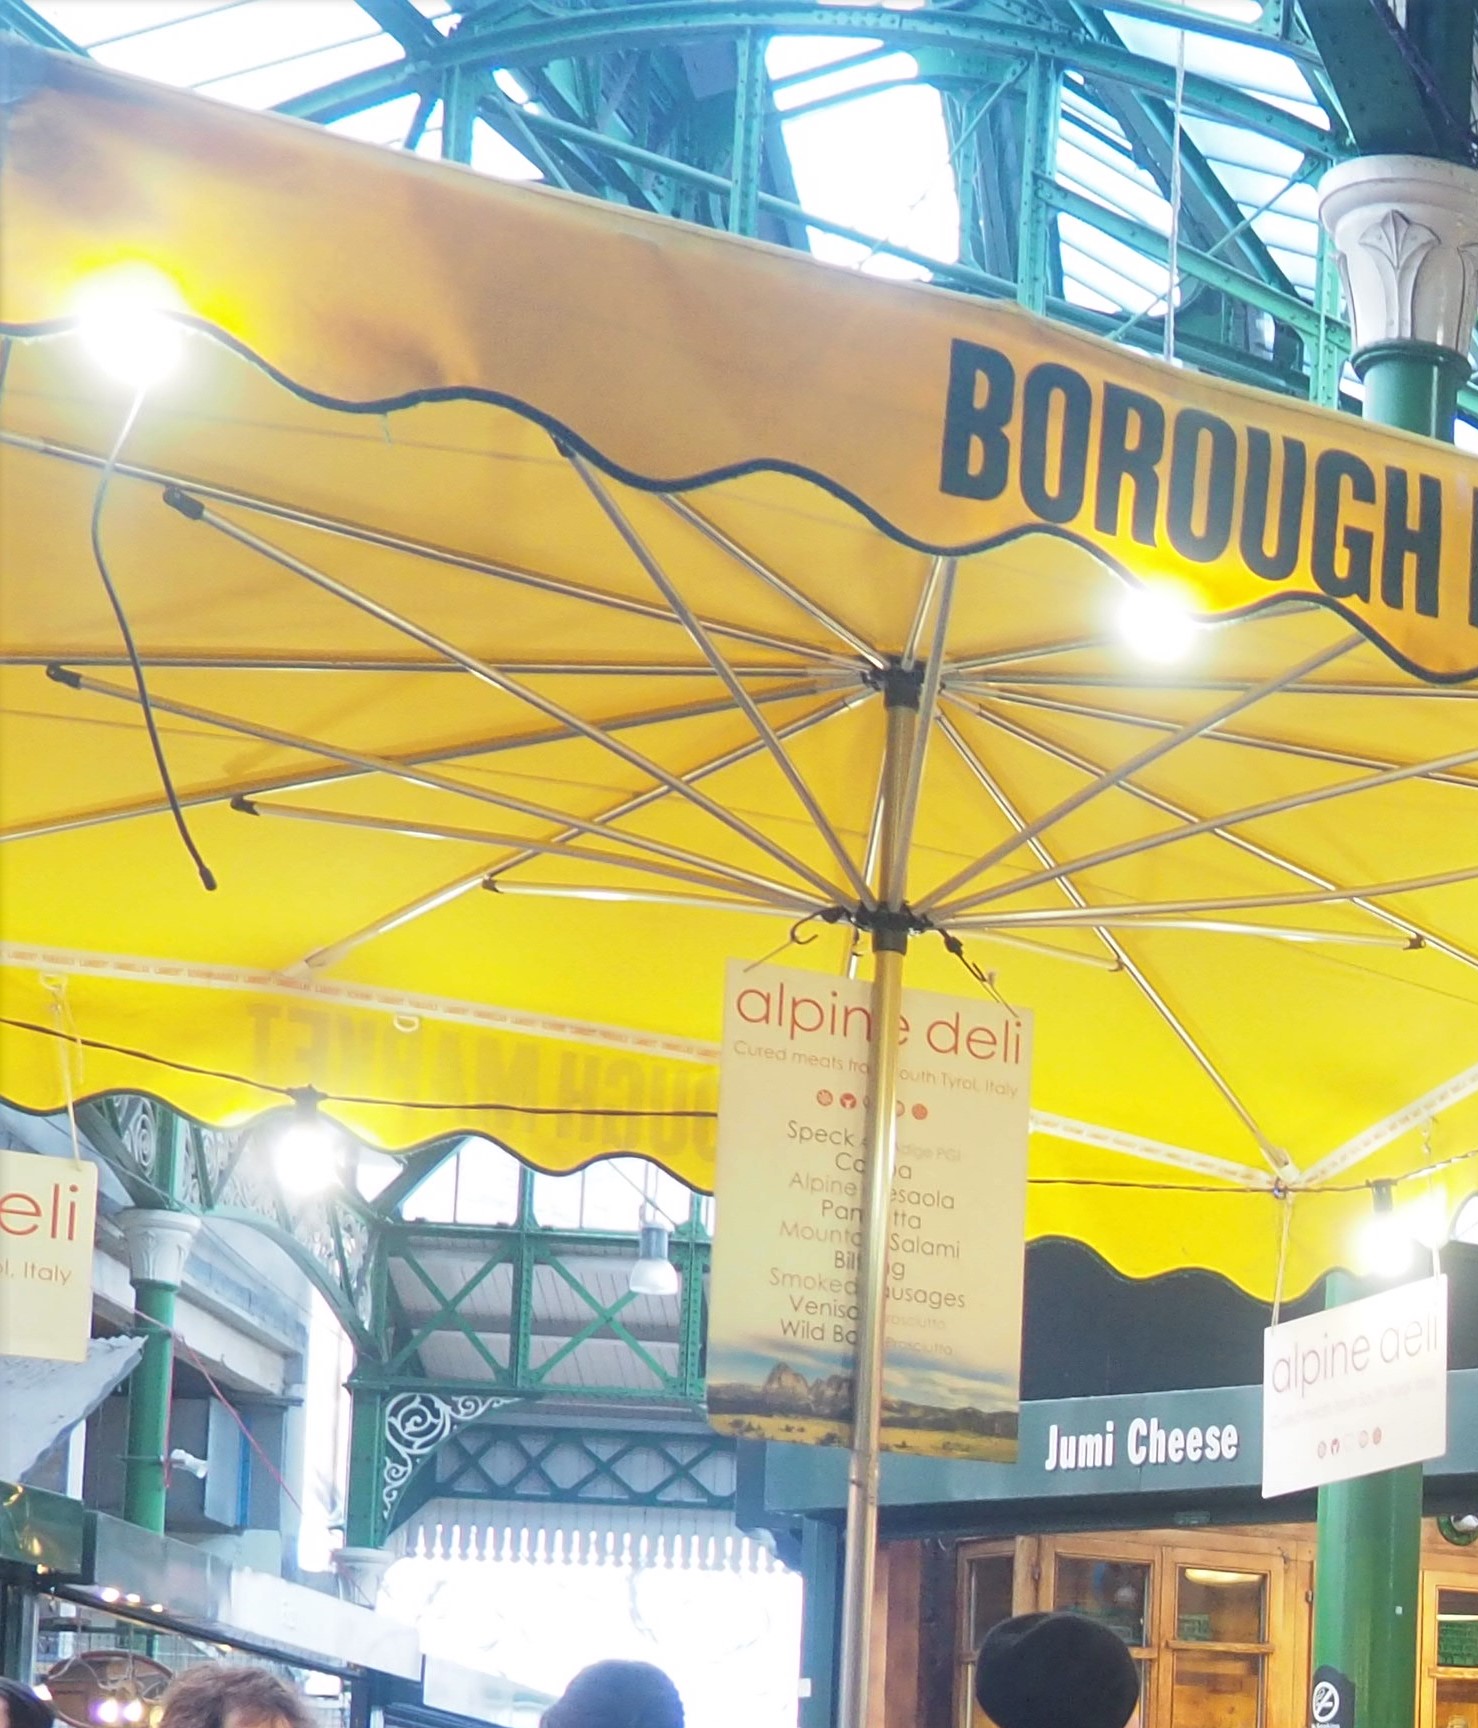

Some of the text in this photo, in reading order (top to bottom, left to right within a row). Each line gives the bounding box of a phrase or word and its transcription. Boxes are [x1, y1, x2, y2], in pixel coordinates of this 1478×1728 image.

[940, 339, 1442, 616] BOROUGH
[927, 1011, 1022, 1064] deli
[734, 1040, 786, 1061] Cured
[792, 1051, 843, 1071] meats
[899, 1069, 936, 1085] outh
[986, 1079, 1019, 1098] Italy
[787, 1120, 855, 1147] Speck
[835, 1152, 912, 1179] Coa
[789, 1172, 857, 1196] Alpine
[0, 1184, 78, 1240] eli
[821, 1199, 922, 1229] Pantta
[890, 1233, 960, 1258] Salami
[24, 1261, 72, 1286] Italy
[790, 1295, 860, 1320] Veniso
[781, 1320, 825, 1341] Wild
[1272, 1331, 1370, 1398] alpine
[1045, 1417, 1238, 1470] Jumi Cheese
